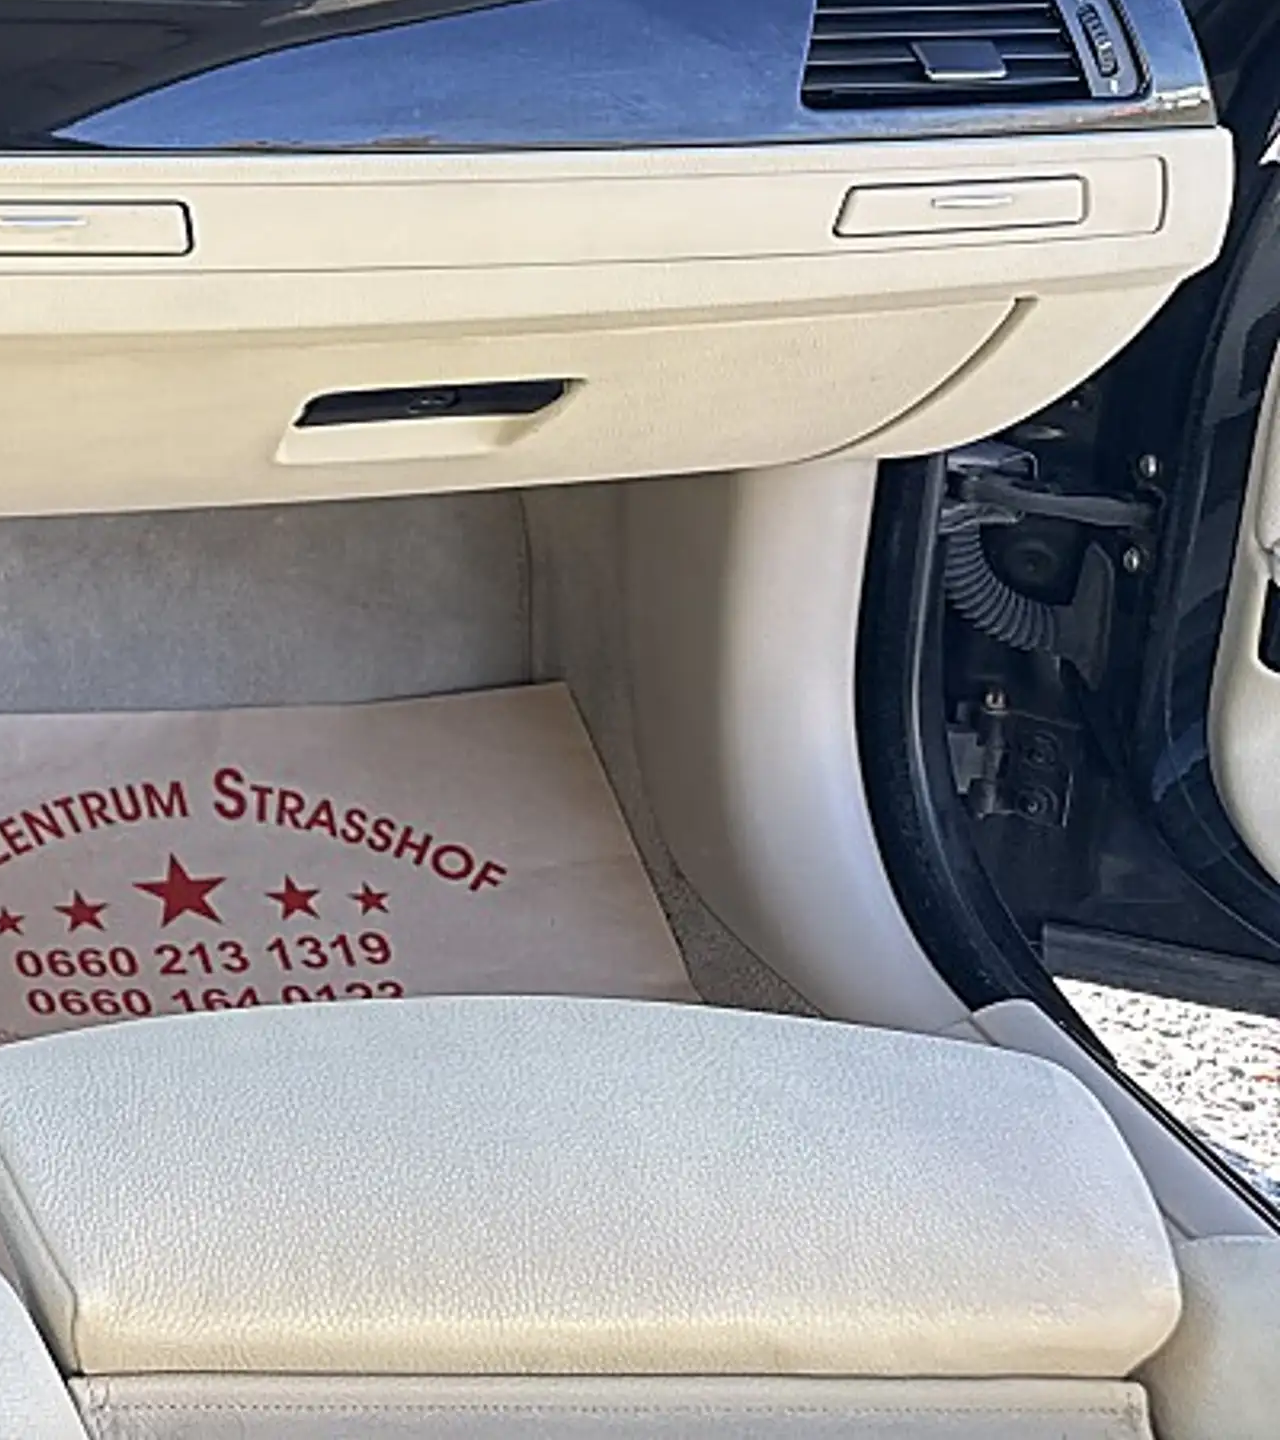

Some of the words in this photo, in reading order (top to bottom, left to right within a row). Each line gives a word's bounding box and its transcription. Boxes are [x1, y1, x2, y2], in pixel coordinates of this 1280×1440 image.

[213, 767, 508, 892] STRASSHOF
[15, 947, 139, 978] 0660
[154, 940, 250, 975] 213
[266, 932, 392, 971] 1319
[26, 988, 152, 1017] 0660
[171, 986, 261, 1012] 164
